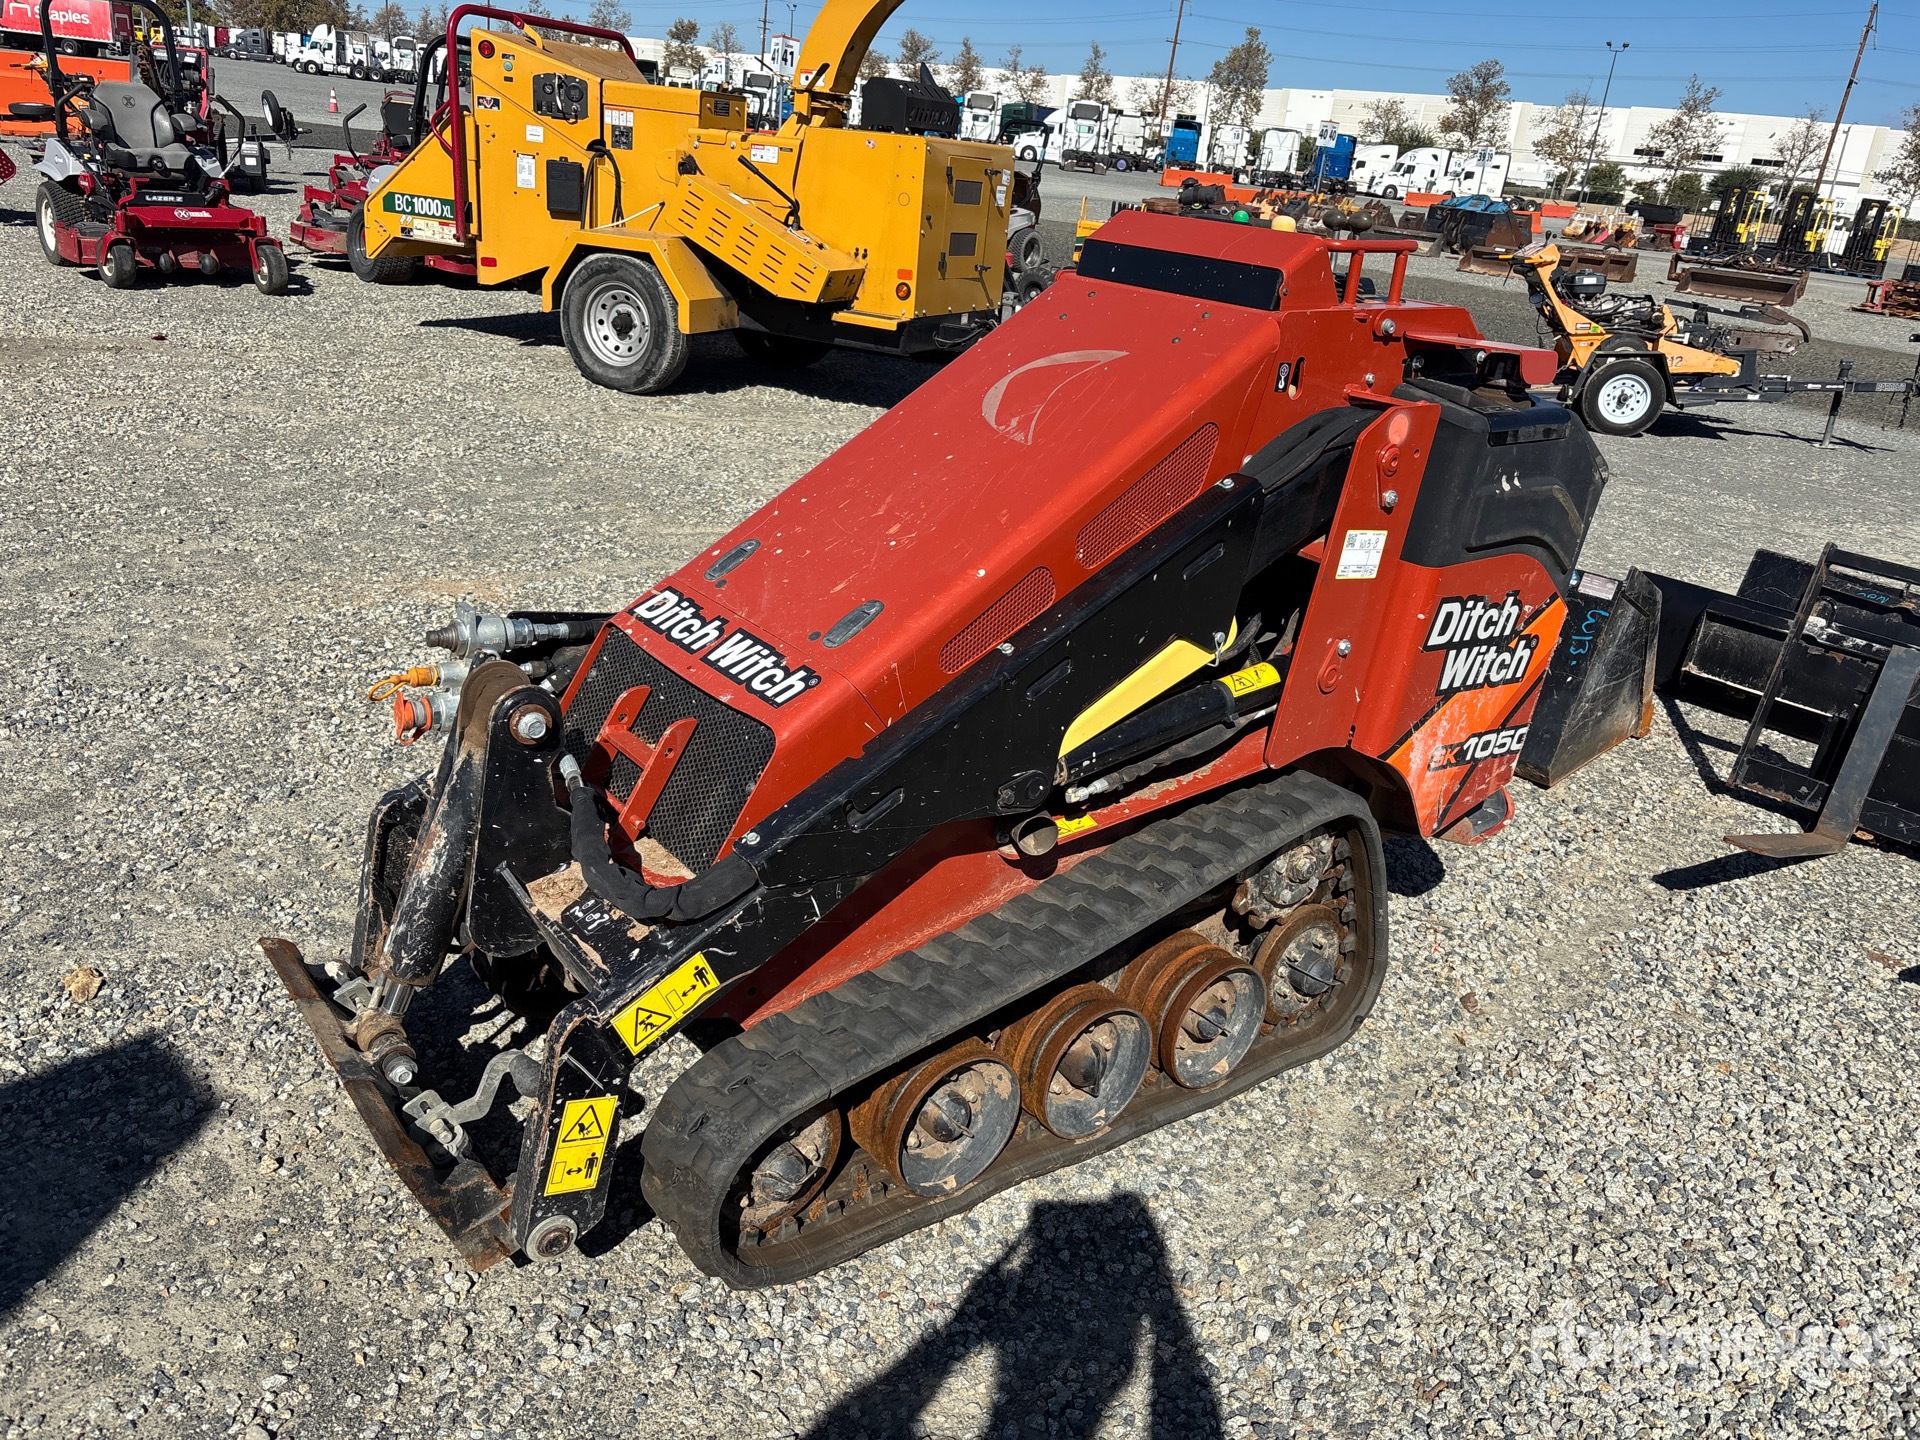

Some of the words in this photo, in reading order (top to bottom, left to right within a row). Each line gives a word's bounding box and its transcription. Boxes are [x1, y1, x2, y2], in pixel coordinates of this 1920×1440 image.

[34, 5, 90, 24] Saples
[771, 48, 780, 64] 41
[781, 49, 794, 67] 41
[714, 64, 723, 74] 21
[1163, 124, 1170, 132] 19
[1318, 129, 1328, 140] 40
[1329, 130, 1337, 141] 40
[1477, 152, 1486, 161] 39
[145, 194, 175, 202] LAZER
[631, 587, 723, 651] Ditch
[1426, 595, 1521, 648] Ditch
